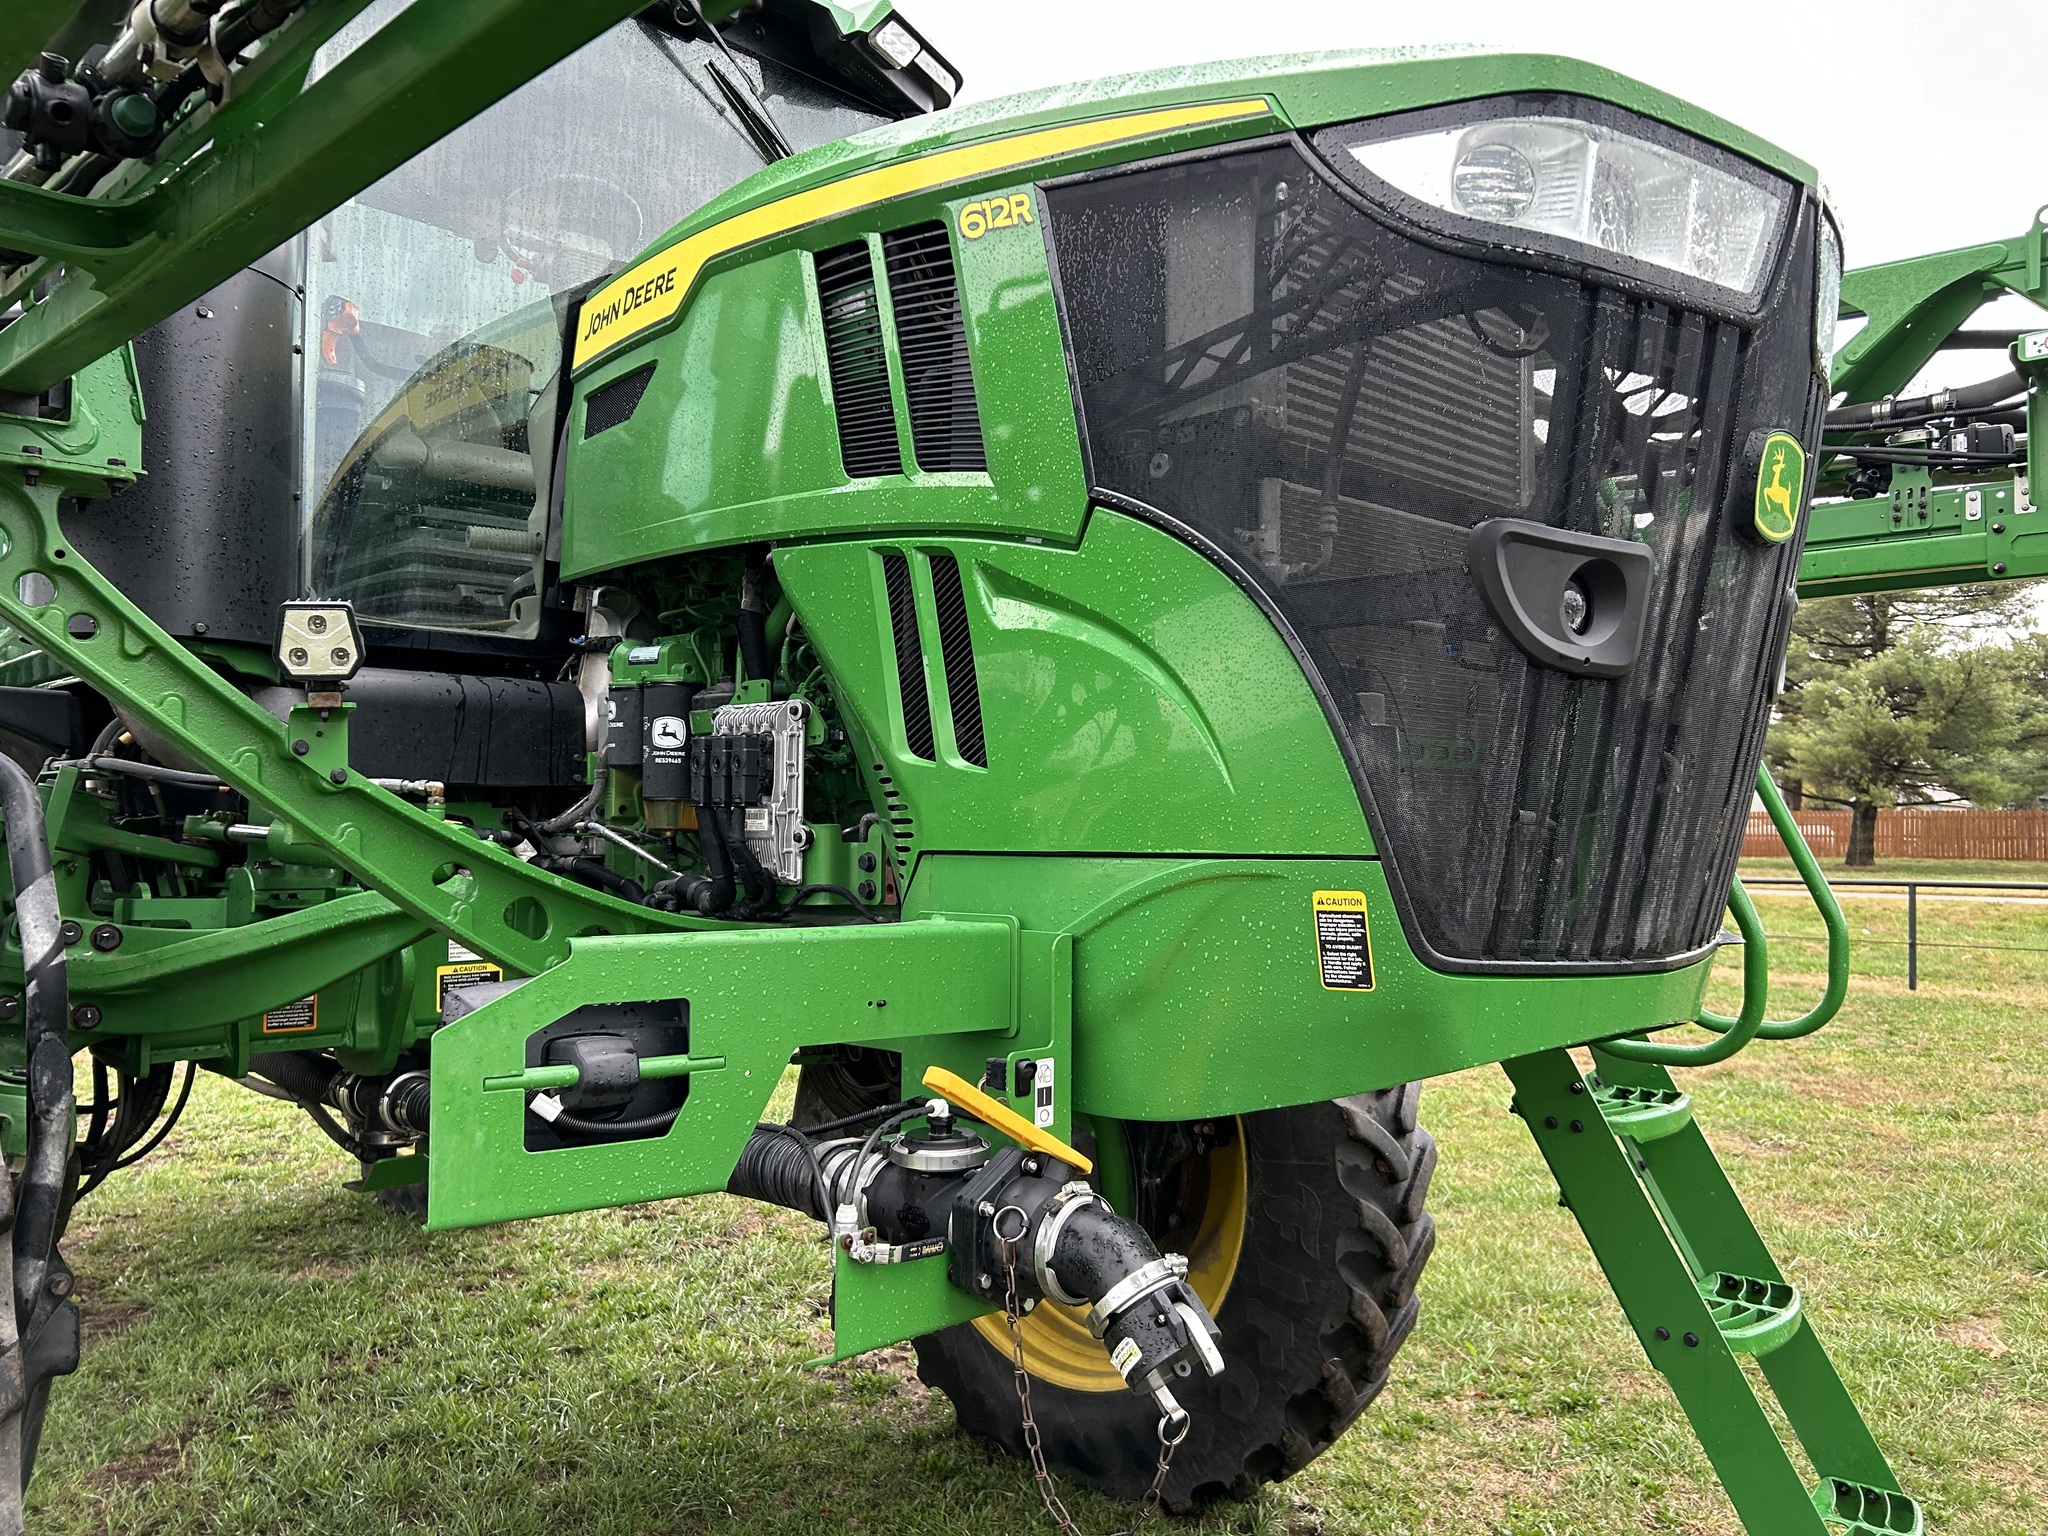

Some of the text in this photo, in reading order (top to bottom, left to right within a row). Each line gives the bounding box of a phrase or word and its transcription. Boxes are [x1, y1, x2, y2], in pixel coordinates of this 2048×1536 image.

[959, 193, 1034, 241] 612R
[584, 266, 677, 342] JOHN DEERE
[1326, 898, 1362, 906] CAUTION
[459, 964, 488, 972] CAUTION
